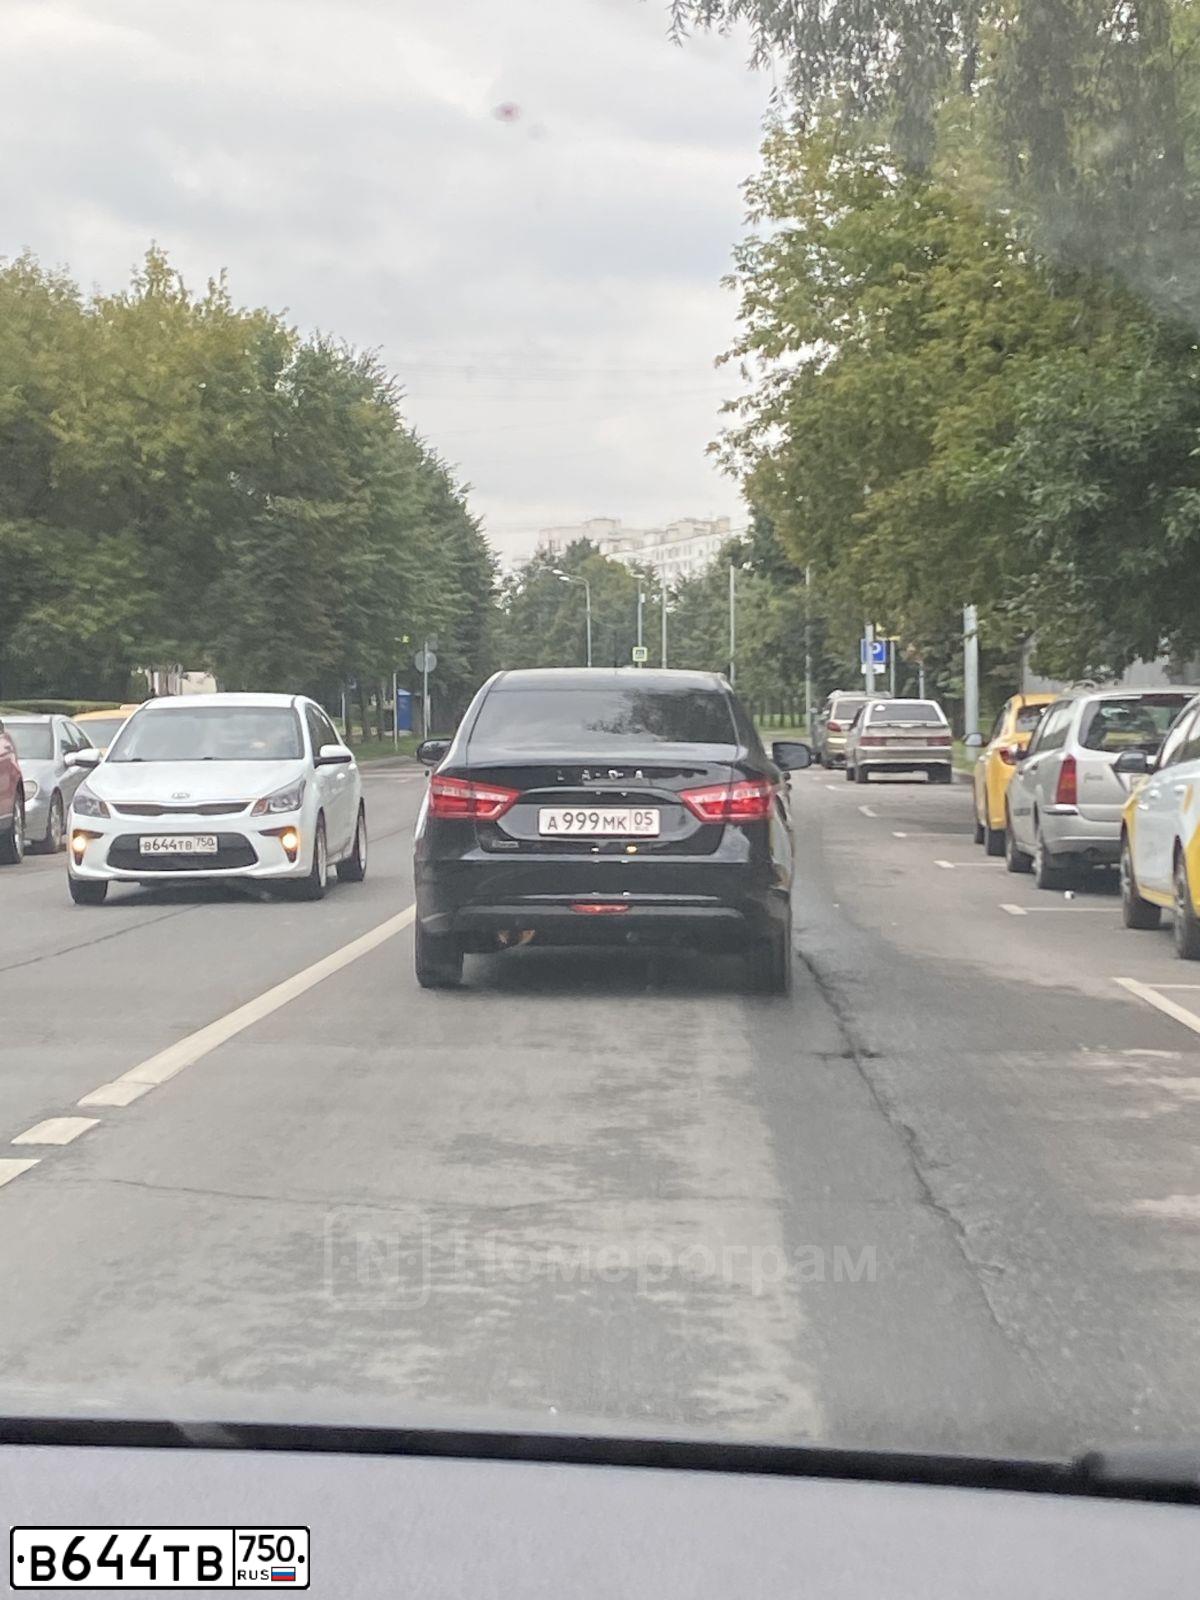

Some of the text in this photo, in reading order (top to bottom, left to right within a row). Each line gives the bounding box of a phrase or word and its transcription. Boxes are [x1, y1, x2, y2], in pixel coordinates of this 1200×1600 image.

[547, 812, 654, 831] А999МК 05
[143, 837, 215, 851] В644ТВ 750
